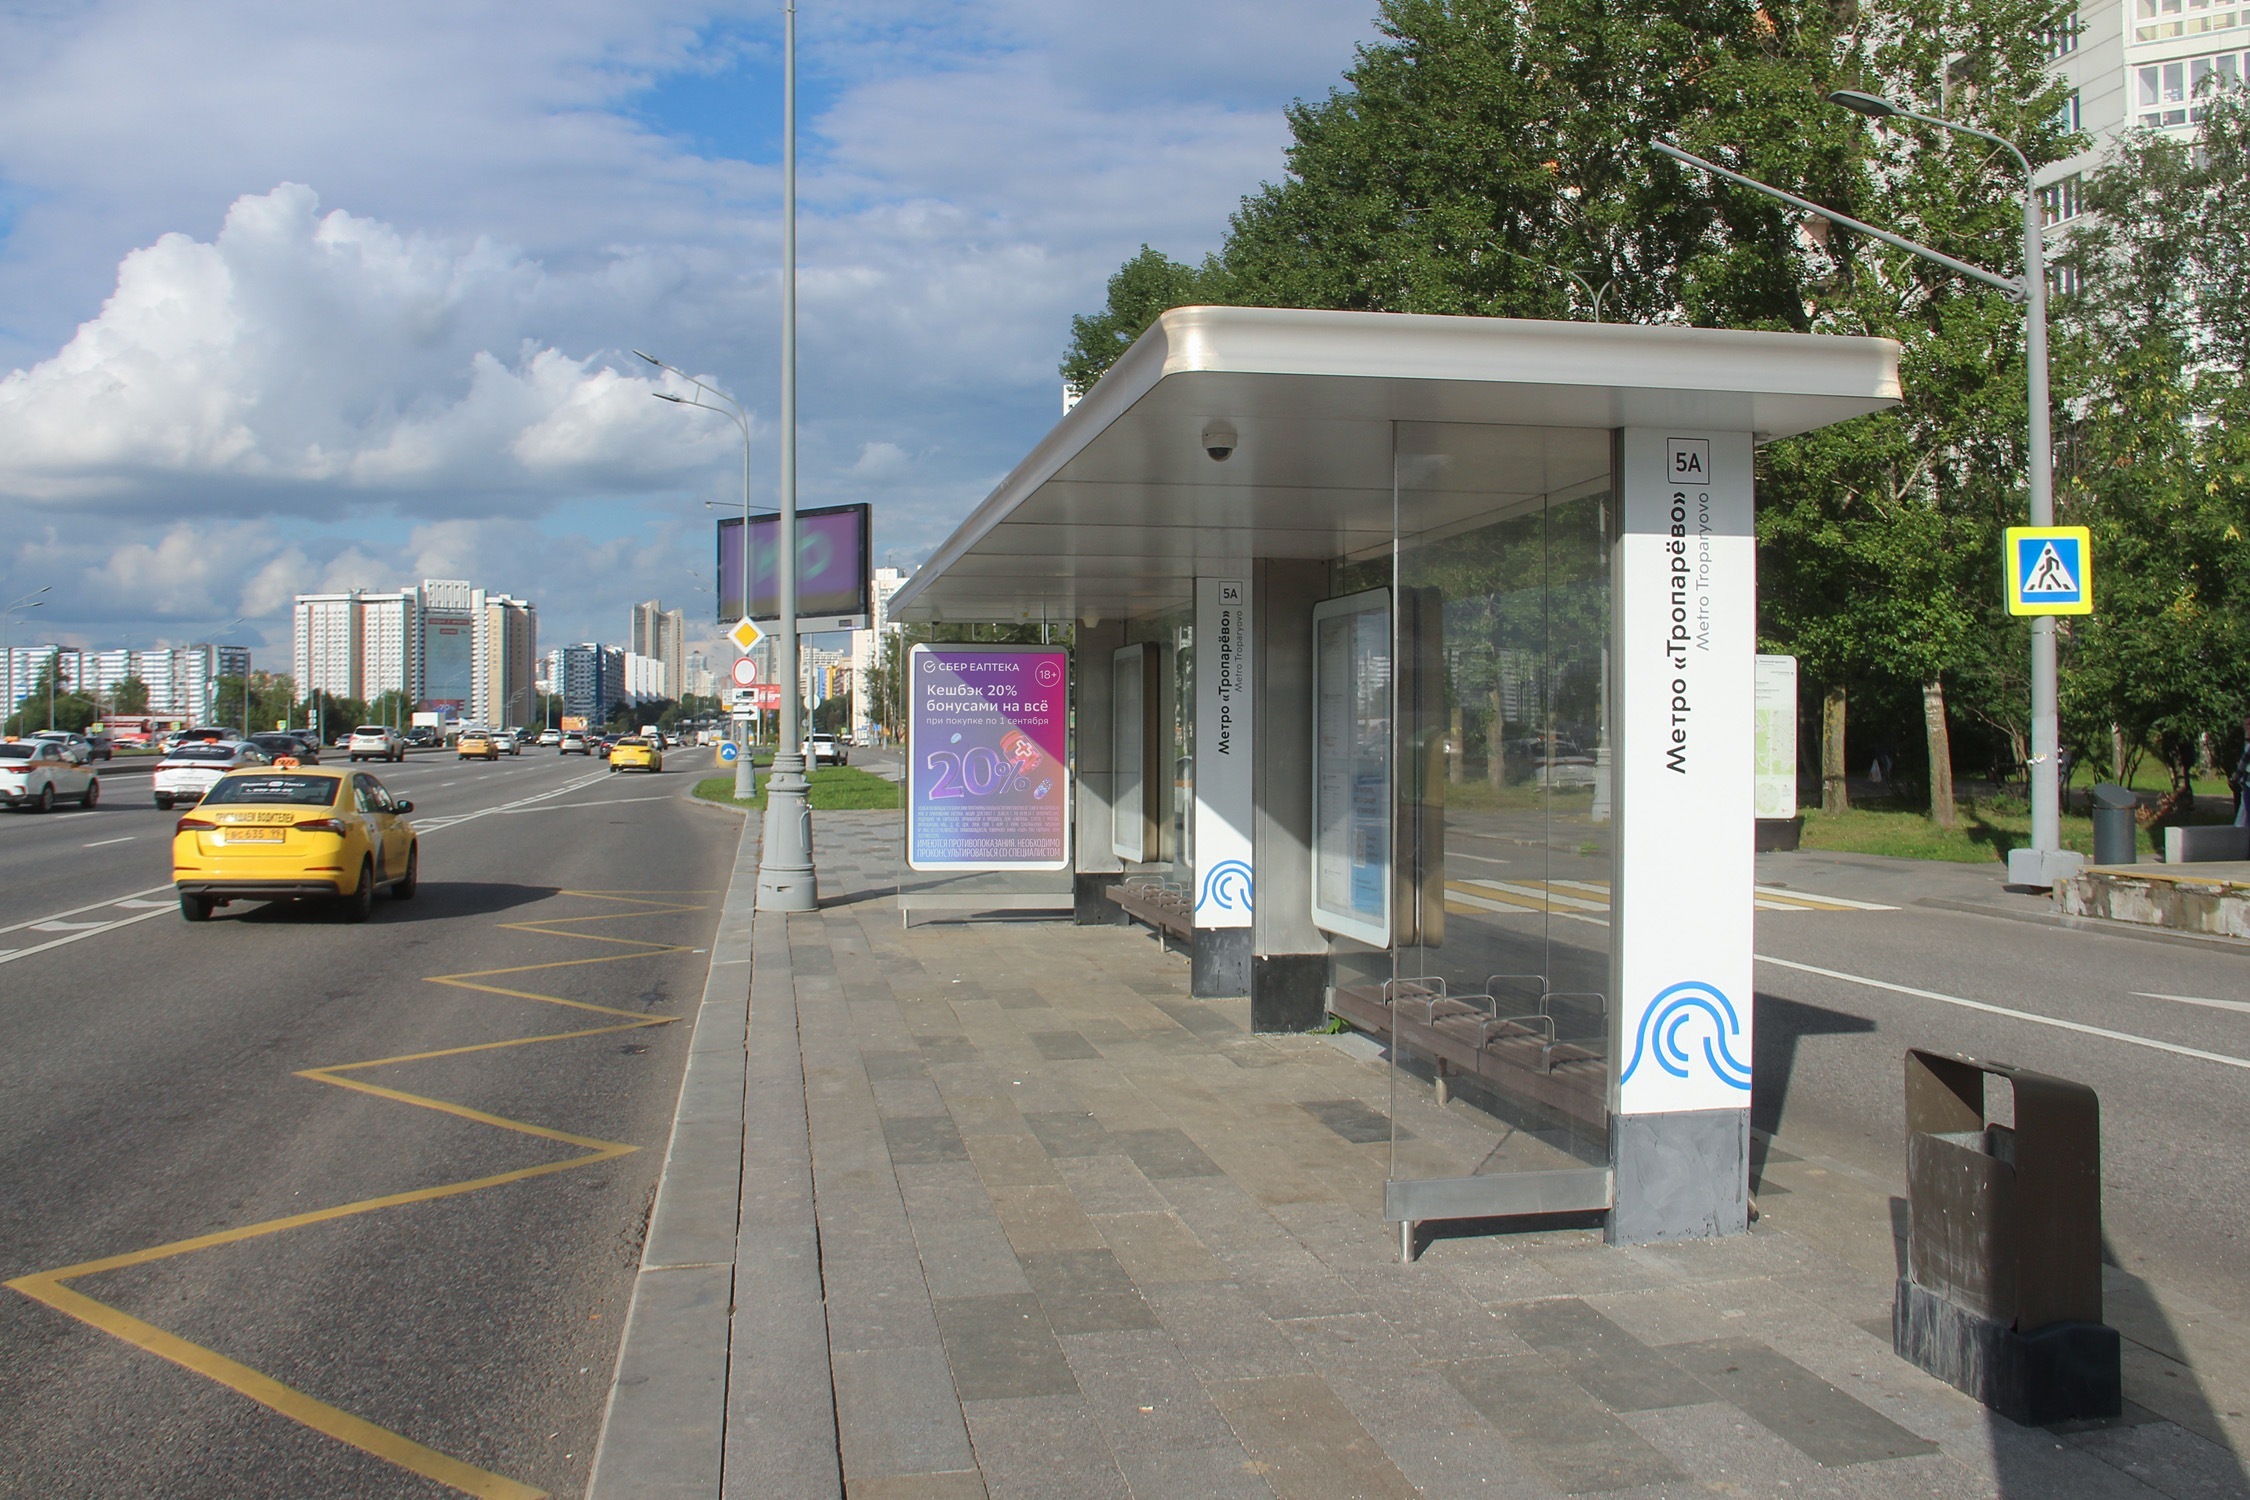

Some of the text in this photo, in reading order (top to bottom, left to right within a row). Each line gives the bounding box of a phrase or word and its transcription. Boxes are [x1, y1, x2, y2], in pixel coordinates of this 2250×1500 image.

[1696, 492, 1713, 652] Metro Troparyovo
[1666, 490, 1691, 775] Метро «Тропарёво»
[1235, 610, 1244, 693] Metro Troparyovo
[938, 662, 1020, 672] СБЕР ЕАПТЕКА
[1039, 670, 1057, 679] 18+
[1218, 610, 1233, 755] Метро «Тропарёво»
[927, 684, 1018, 697] Кешбэк 20%
[926, 700, 1049, 714] бонусами на всё
[926, 717, 943, 725] при
[946, 717, 983, 726] покупке
[1000, 717, 1005, 725] 1
[1007, 717, 1049, 726] сентября
[927, 746, 1031, 800] 20%
[917, 839, 1060, 848] ИМЕЮТСЯ ПРОТИВОПОКАЗАНИЯ. НЕОБХОДИМО
[917, 848, 1060, 858] ПРОКОНСУЛЬТИРОВАТЬСЯ СО СПЕЦИАЛИСТОМ
